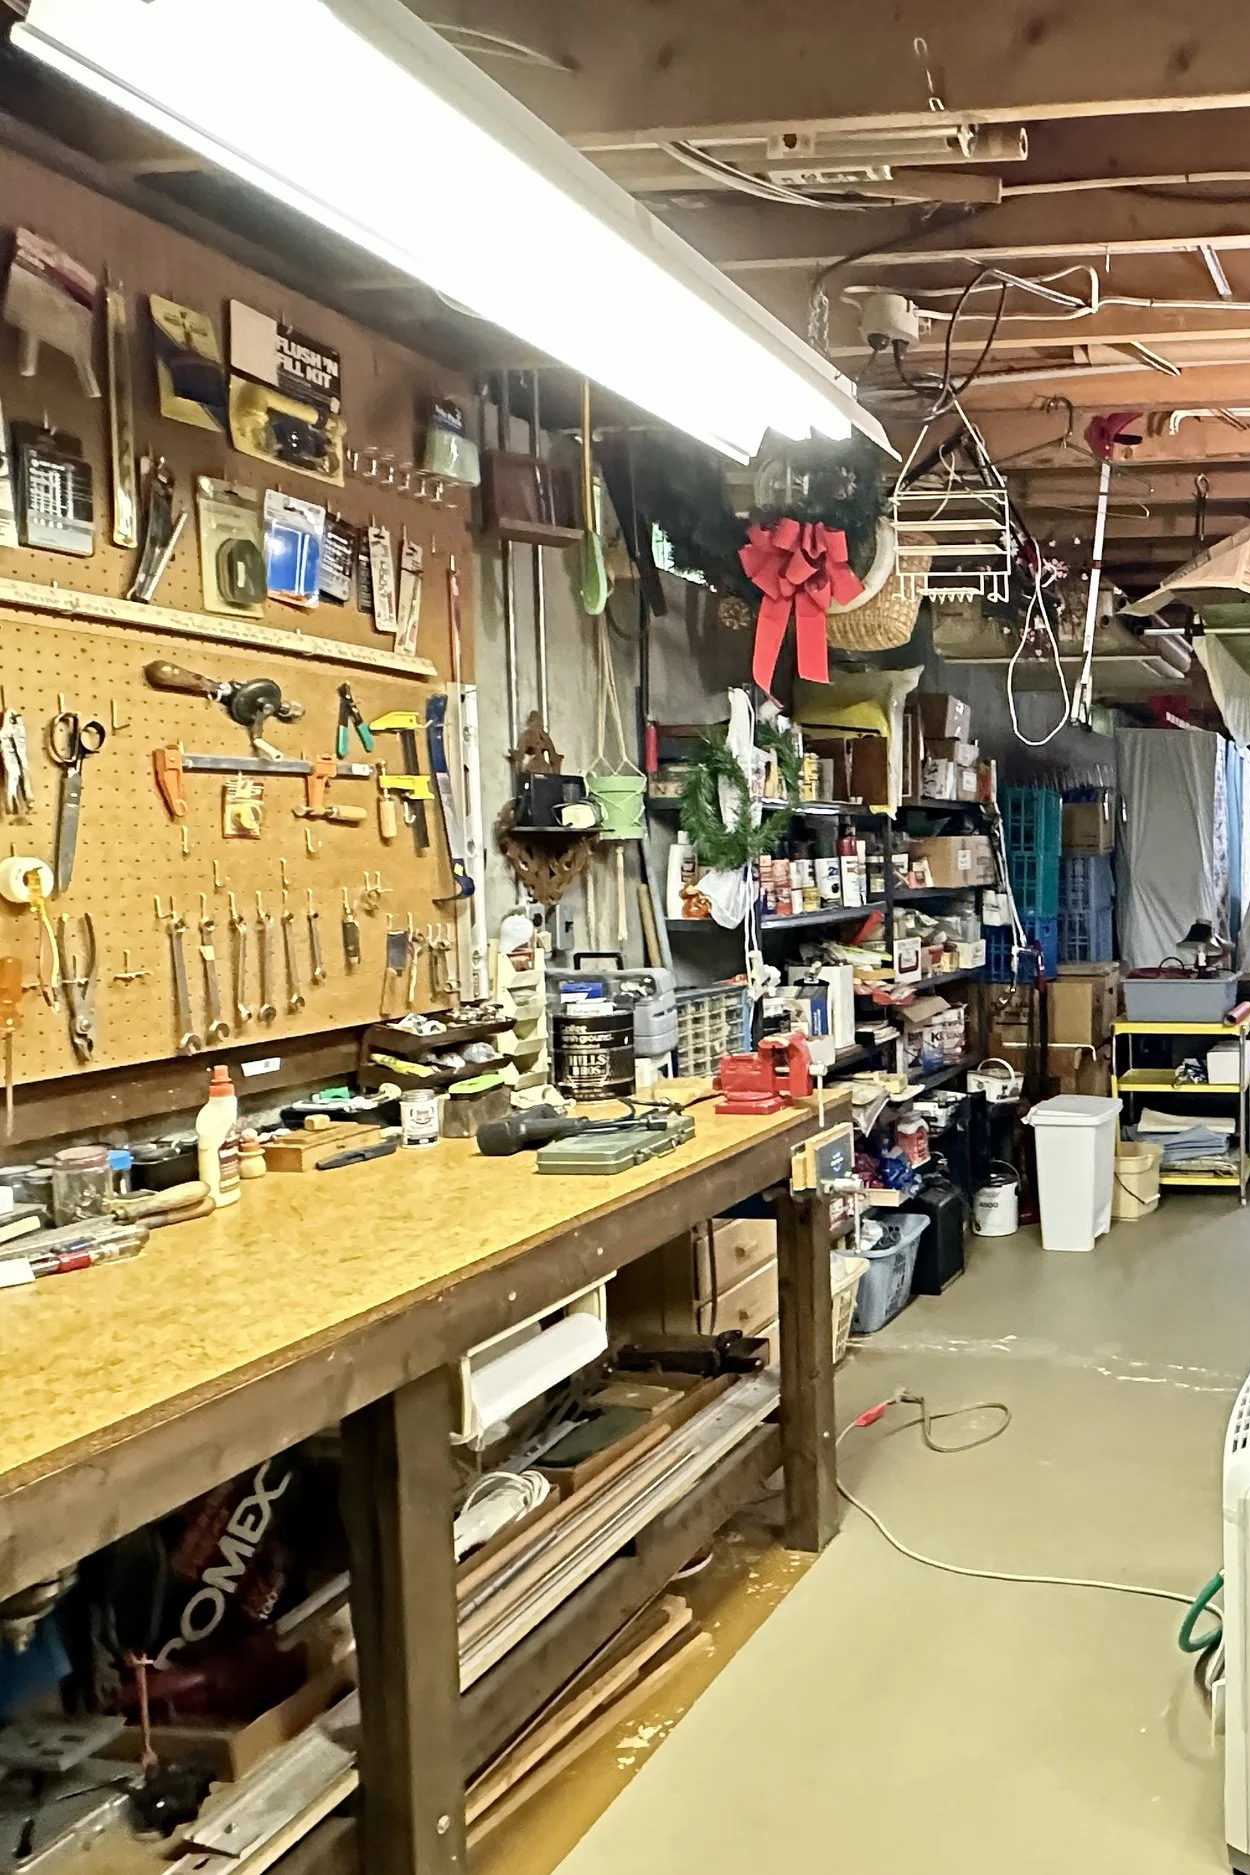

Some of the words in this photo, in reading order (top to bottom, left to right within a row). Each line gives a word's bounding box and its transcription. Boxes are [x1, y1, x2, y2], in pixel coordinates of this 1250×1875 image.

[277, 334, 322, 369] FLUSH
[277, 351, 304, 377] FILL
[306, 365, 332, 388] KIT
[568, 1055, 607, 1065] HILLS
